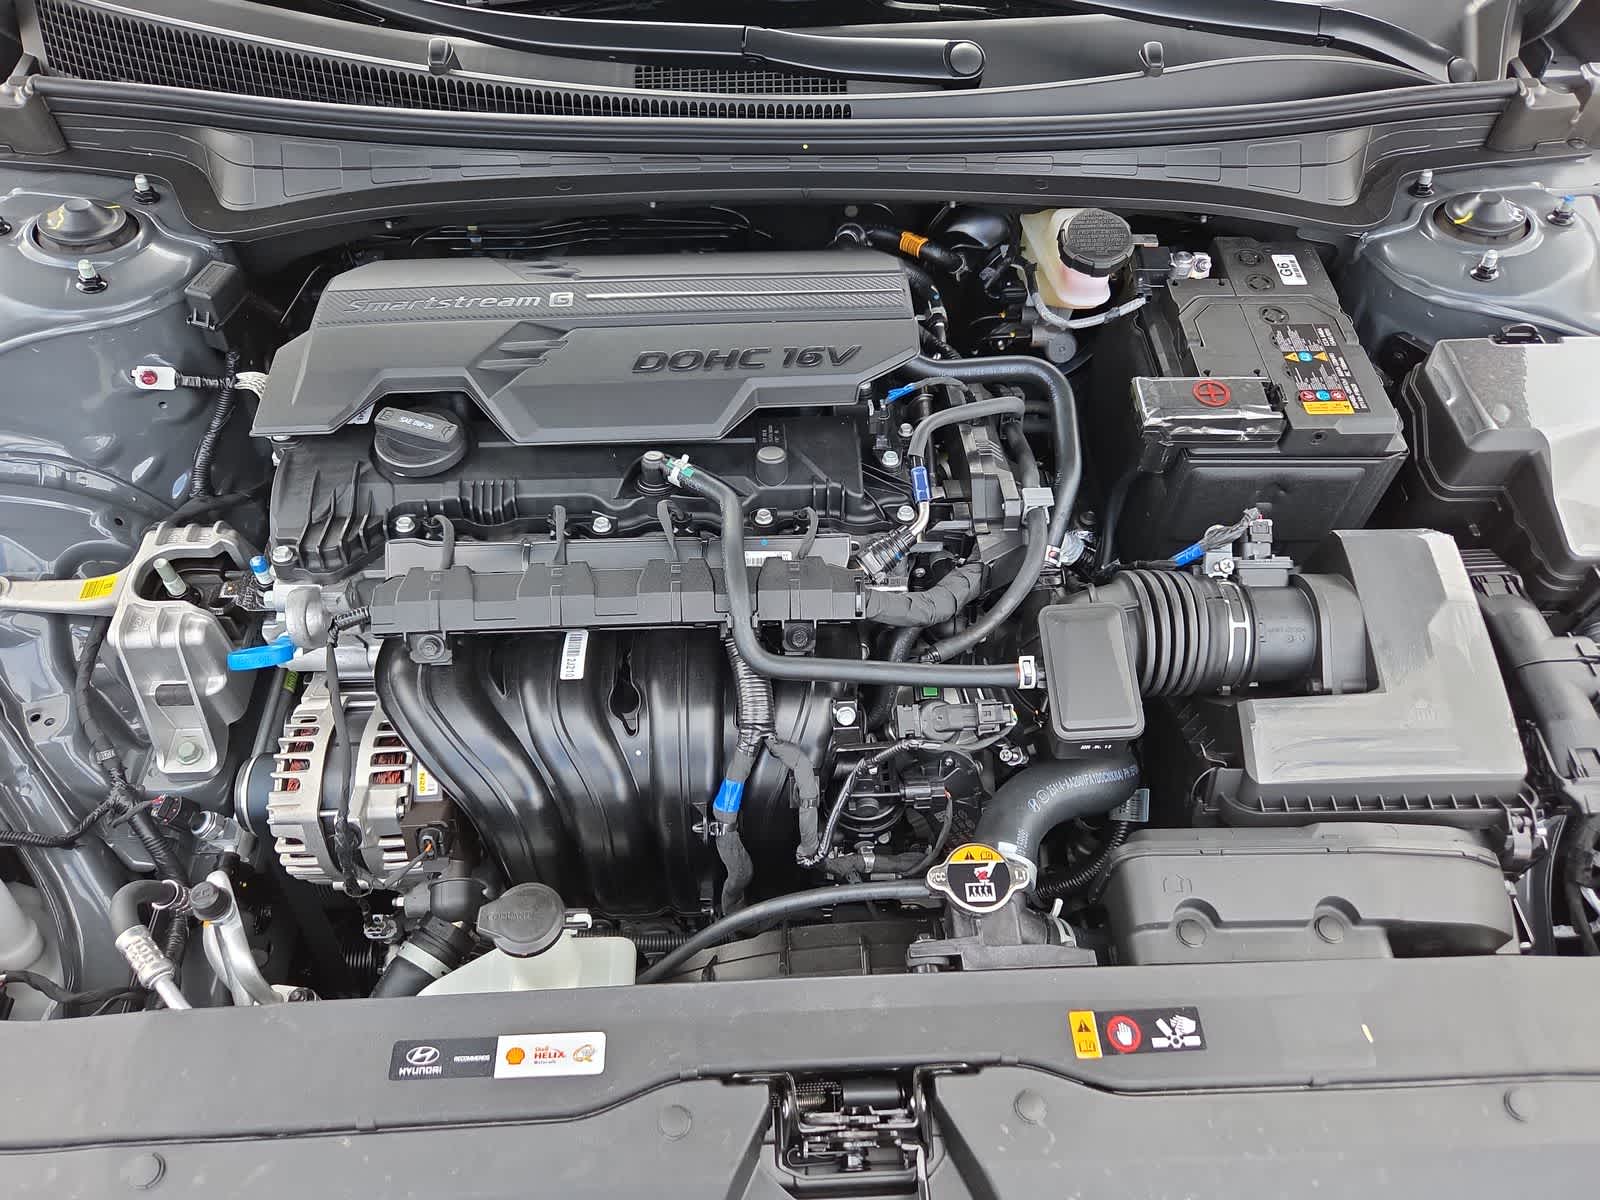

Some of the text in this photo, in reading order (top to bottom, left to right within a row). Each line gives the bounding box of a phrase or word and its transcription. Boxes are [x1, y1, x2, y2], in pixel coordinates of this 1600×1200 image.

[1277, 262, 1293, 277] G6
[344, 292, 574, 312] Smartstream G
[632, 344, 863, 374] DOHC 16V
[534, 1051, 566, 1060] HELIX
[399, 1066, 442, 1076] HYUNDAI
